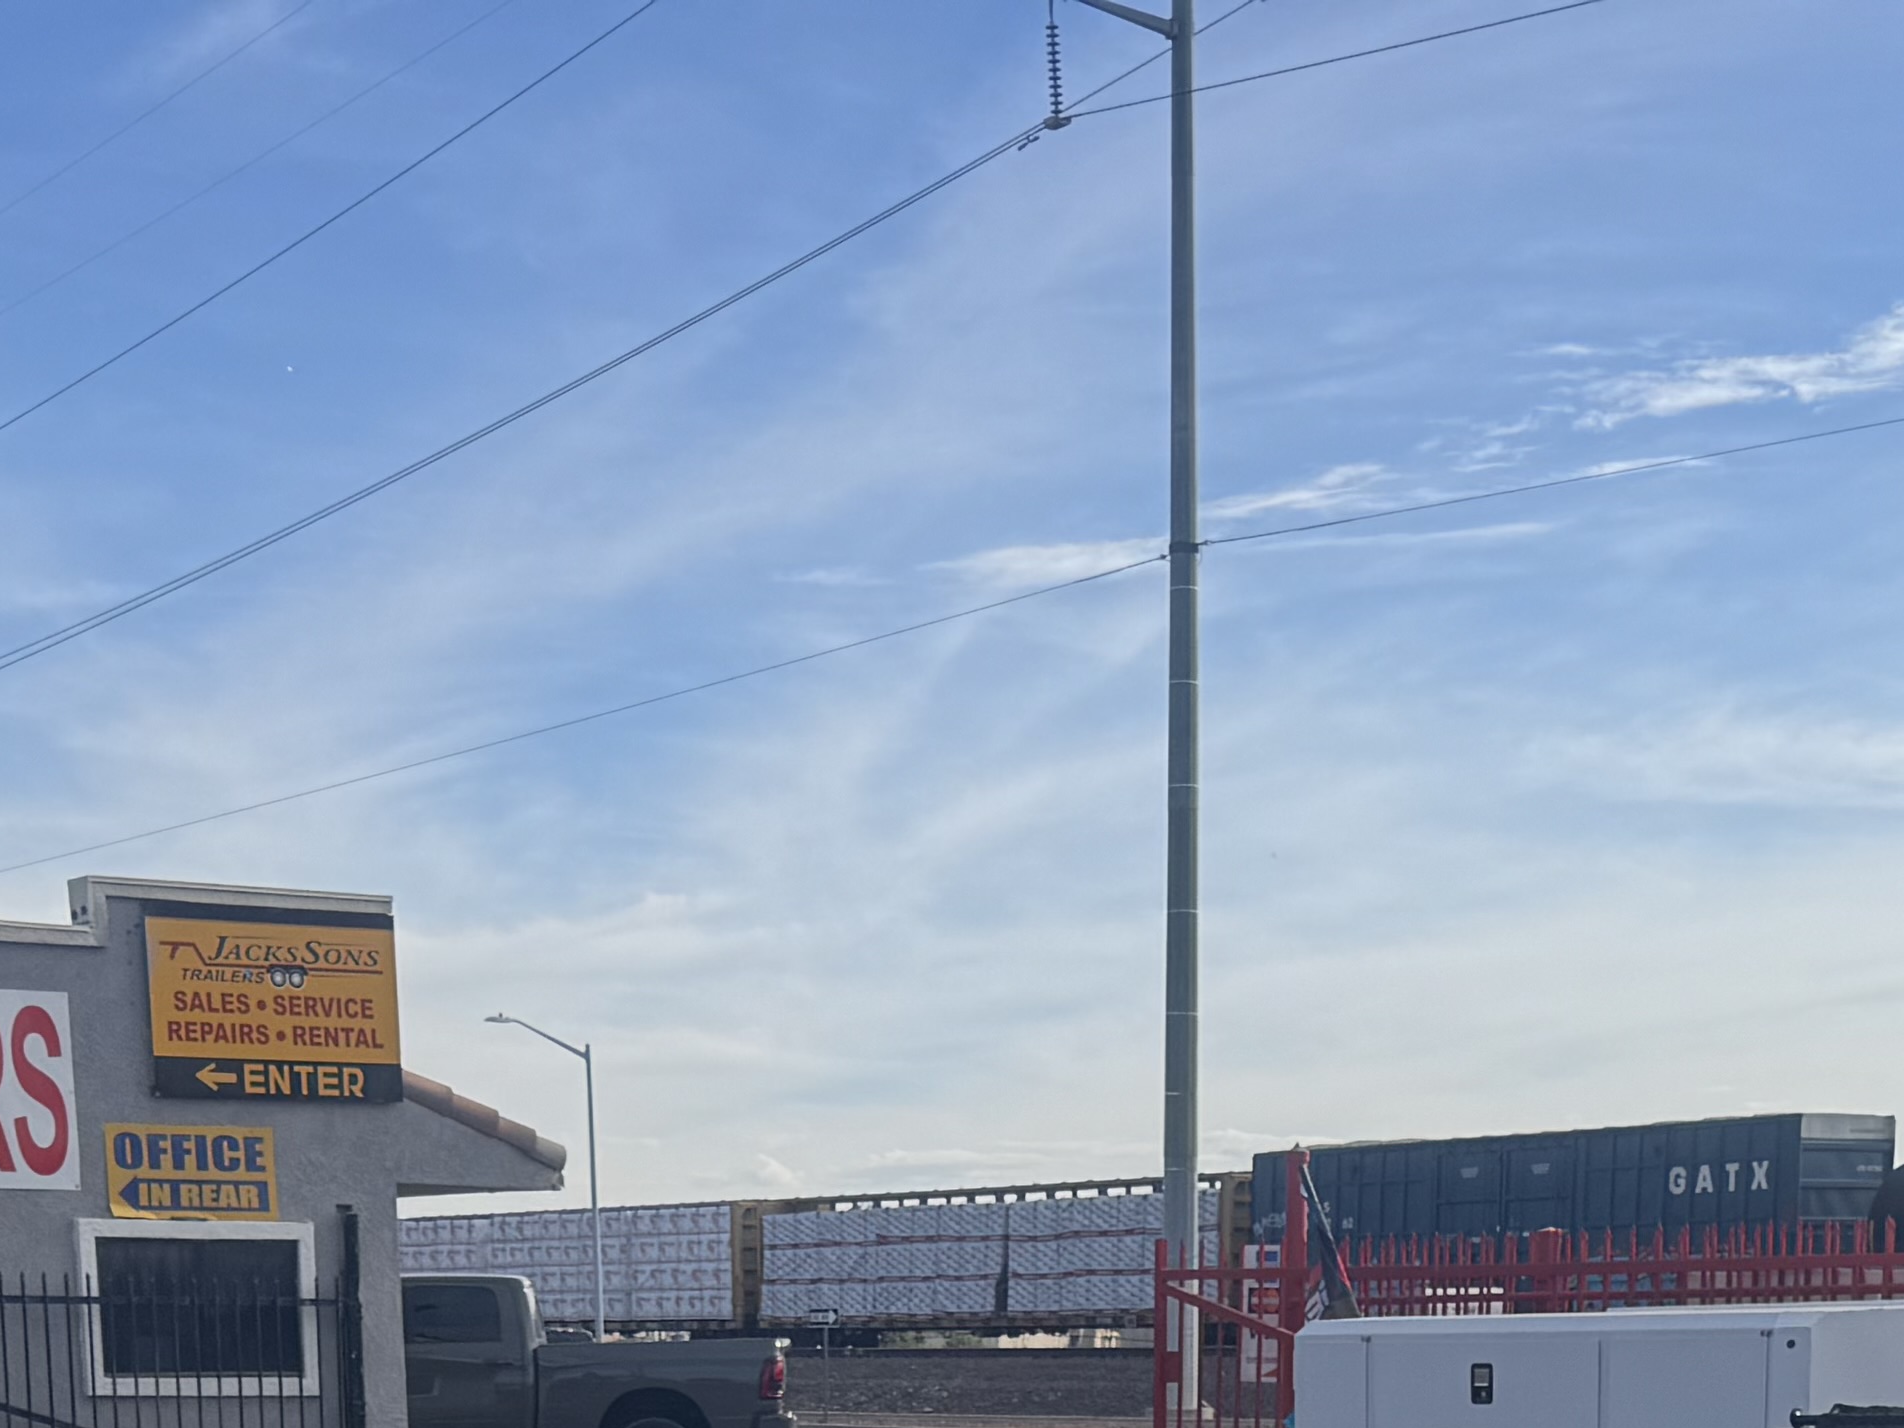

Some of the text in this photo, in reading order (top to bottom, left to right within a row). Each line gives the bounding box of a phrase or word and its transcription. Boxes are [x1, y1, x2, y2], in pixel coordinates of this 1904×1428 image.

[181, 968, 265, 984] TRAILERS
[173, 991, 375, 1019] SALES SERVICE
[168, 1021, 384, 1048] REPAIRS RENTAL
[243, 1063, 366, 1098] ENTER
[113, 1132, 266, 1173] OFFICE
[1668, 1161, 1770, 1195] GATX
[138, 1183, 260, 1208] IN REAR
